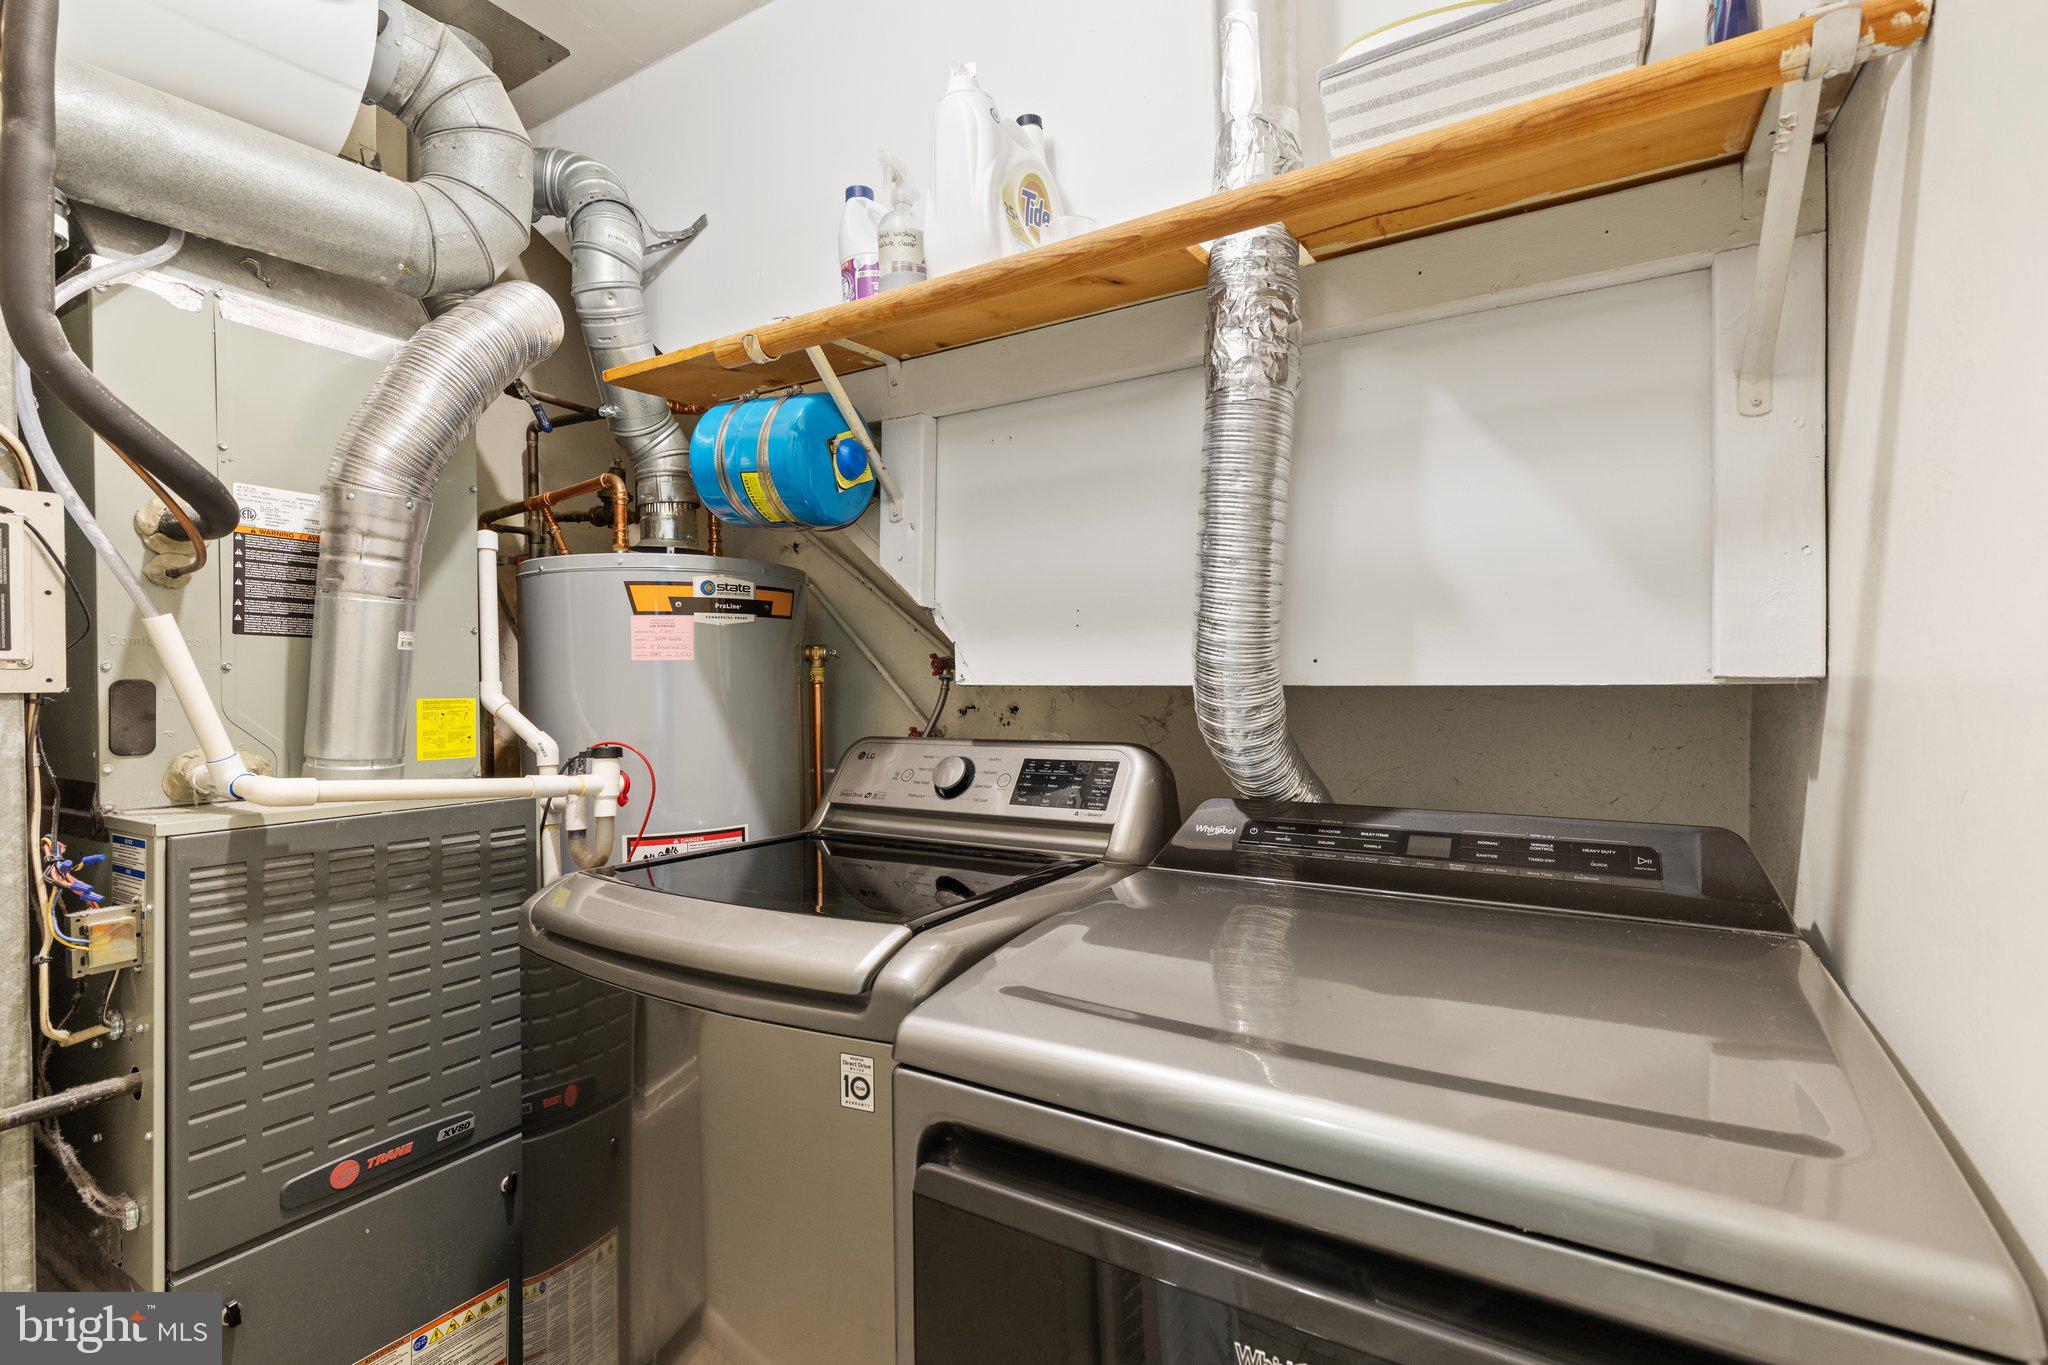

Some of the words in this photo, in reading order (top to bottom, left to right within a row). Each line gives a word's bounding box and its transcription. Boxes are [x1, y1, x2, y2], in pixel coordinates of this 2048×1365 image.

[259, 529, 295, 539] WARNING
[716, 583, 751, 593] state
[865, 752, 876, 760] LG
[1195, 823, 1237, 836] Whirlpool
[680, 836, 705, 844] DANGER
[843, 1074, 871, 1101] 10
[442, 1121, 471, 1139] XV80
[366, 1141, 414, 1170] TRANE
